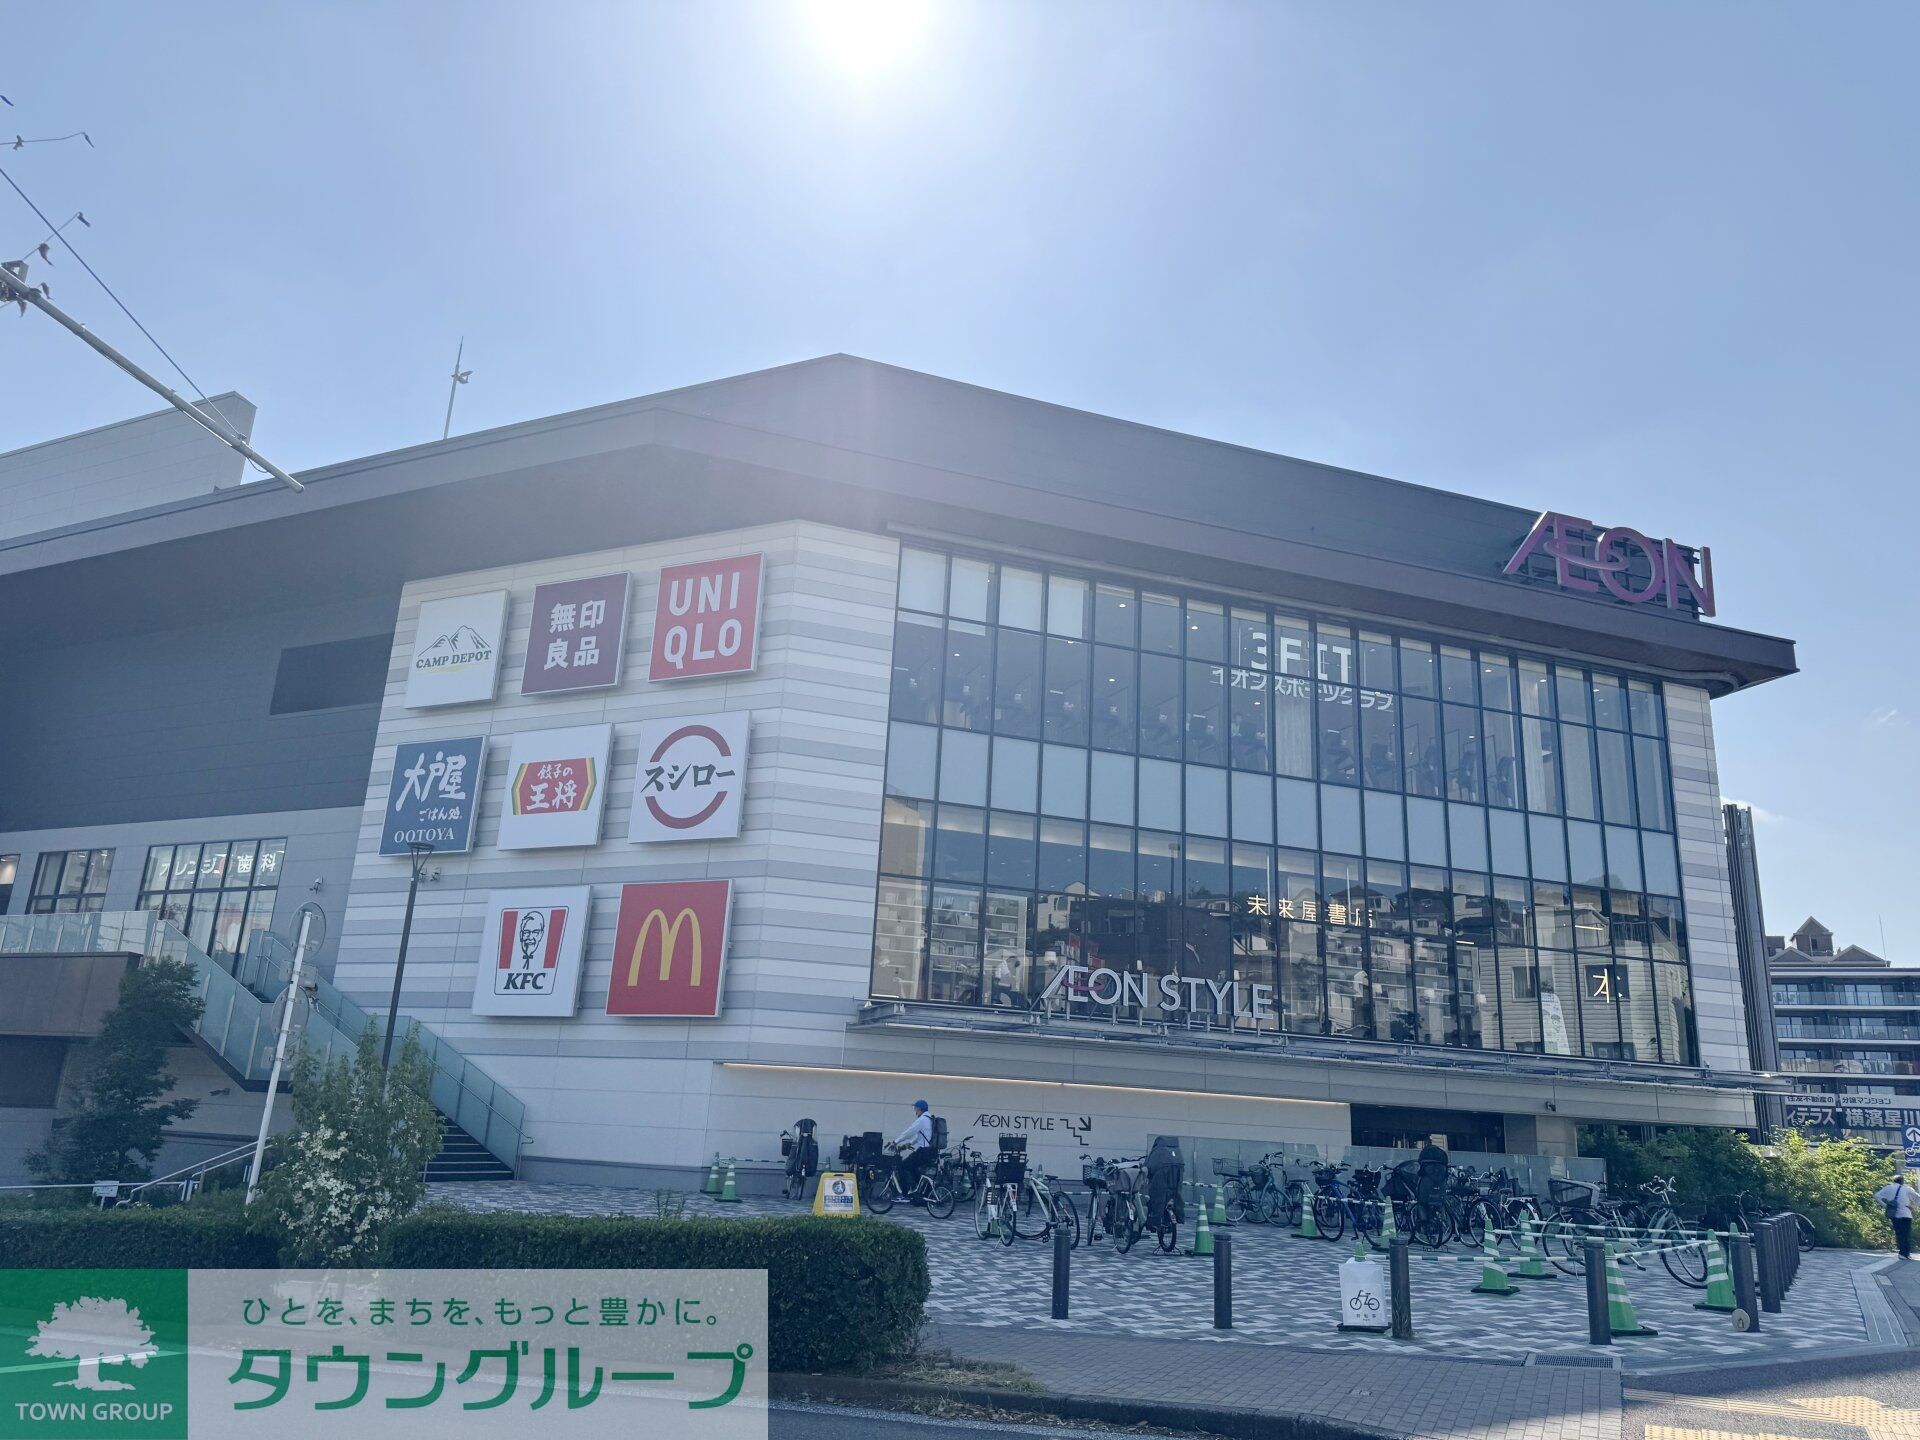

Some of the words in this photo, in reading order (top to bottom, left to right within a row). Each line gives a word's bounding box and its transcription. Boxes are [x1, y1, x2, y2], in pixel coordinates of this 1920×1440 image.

[668, 571, 741, 617] UNI
[549, 599, 606, 632] 無印
[416, 655, 450, 670] CAMP
[450, 649, 492, 666] DEPOT
[543, 636, 600, 671] 良品
[663, 618, 742, 669] QLO
[395, 751, 467, 812] 大戸屋
[538, 764, 573, 781] 餃子の
[640, 762, 736, 794] スシロー
[526, 780, 578, 812] 王将
[418, 805, 462, 823] ごはん処
[394, 827, 455, 844] OOTOYA
[503, 973, 547, 991] KFC
[1160, 975, 1273, 1020] STYLE
[1014, 1116, 1054, 1130] STYLE
